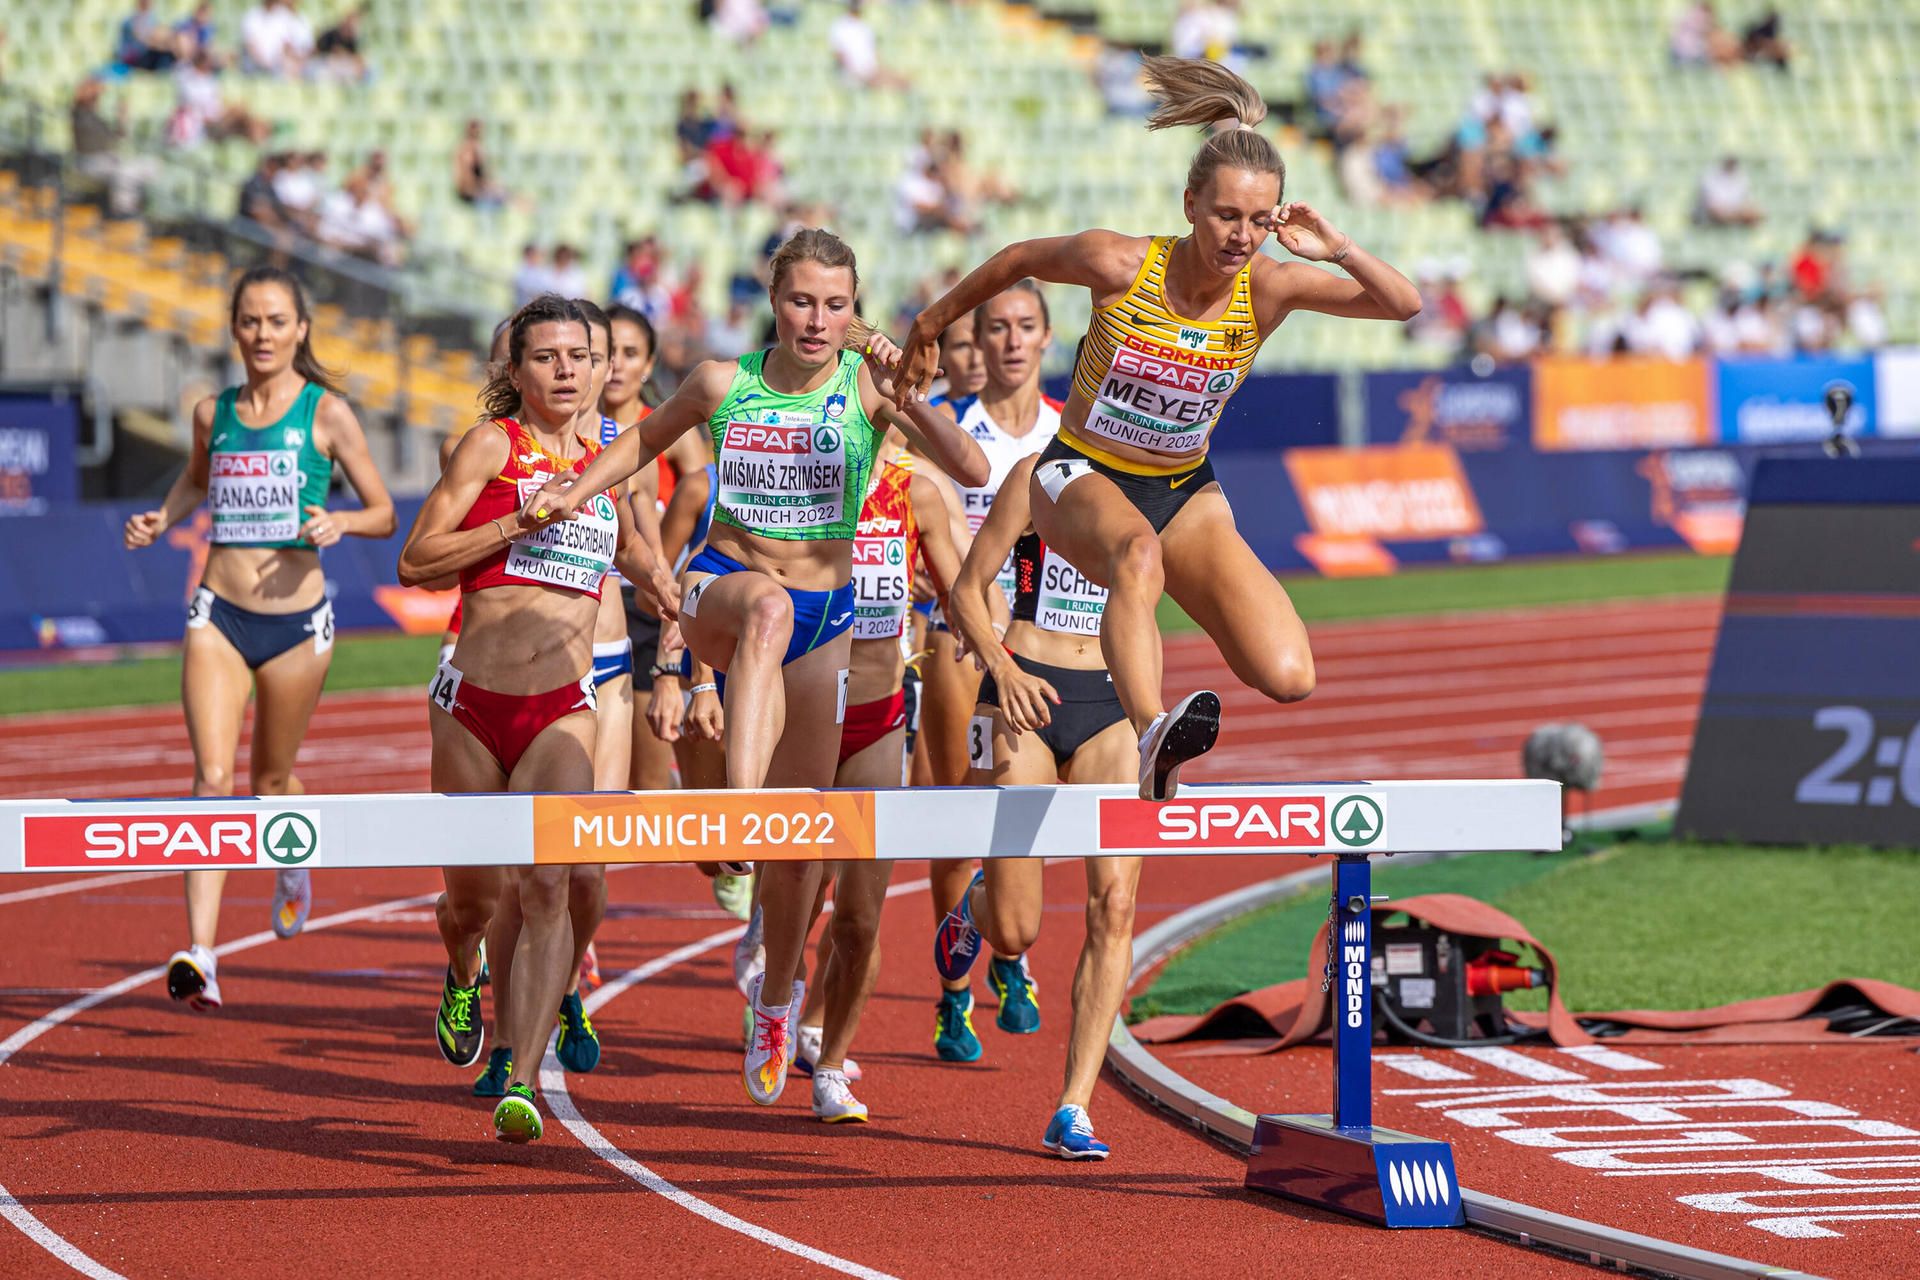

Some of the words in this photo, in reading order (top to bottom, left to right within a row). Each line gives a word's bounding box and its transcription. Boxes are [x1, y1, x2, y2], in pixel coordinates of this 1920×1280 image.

[1124, 335, 1239, 370] GERMANY
[1116, 355, 1206, 390] SPAR
[1103, 379, 1219, 422] MEYER
[1094, 416, 1162, 446] MUNICH
[1165, 433, 1201, 449] 2022
[1127, 414, 1152, 427] RUN
[727, 426, 809, 450] SPAR
[722, 456, 776, 489] MIŠMAŠ
[779, 460, 842, 490] ZRIMŠEK
[726, 507, 791, 523] MUNICH
[797, 506, 835, 523] 2022
[753, 496, 776, 504] RUN
[524, 521, 614, 558] NCHEZ-ESCRIBANO
[852, 543, 883, 562] AR
[514, 558, 576, 583] MUNICH
[544, 552, 565, 562] RUN
[1045, 565, 1104, 597] SCHL
[1072, 602, 1094, 612] RUN
[868, 619, 896, 635] 2022
[432, 669, 455, 709] 14
[971, 723, 984, 761] 3
[573, 813, 726, 848] MUNICH
[742, 811, 835, 845] 2022
[1157, 804, 1321, 841] SPAR
[84, 821, 253, 859] SPAR
[1344, 945, 1366, 1028] MONDO
